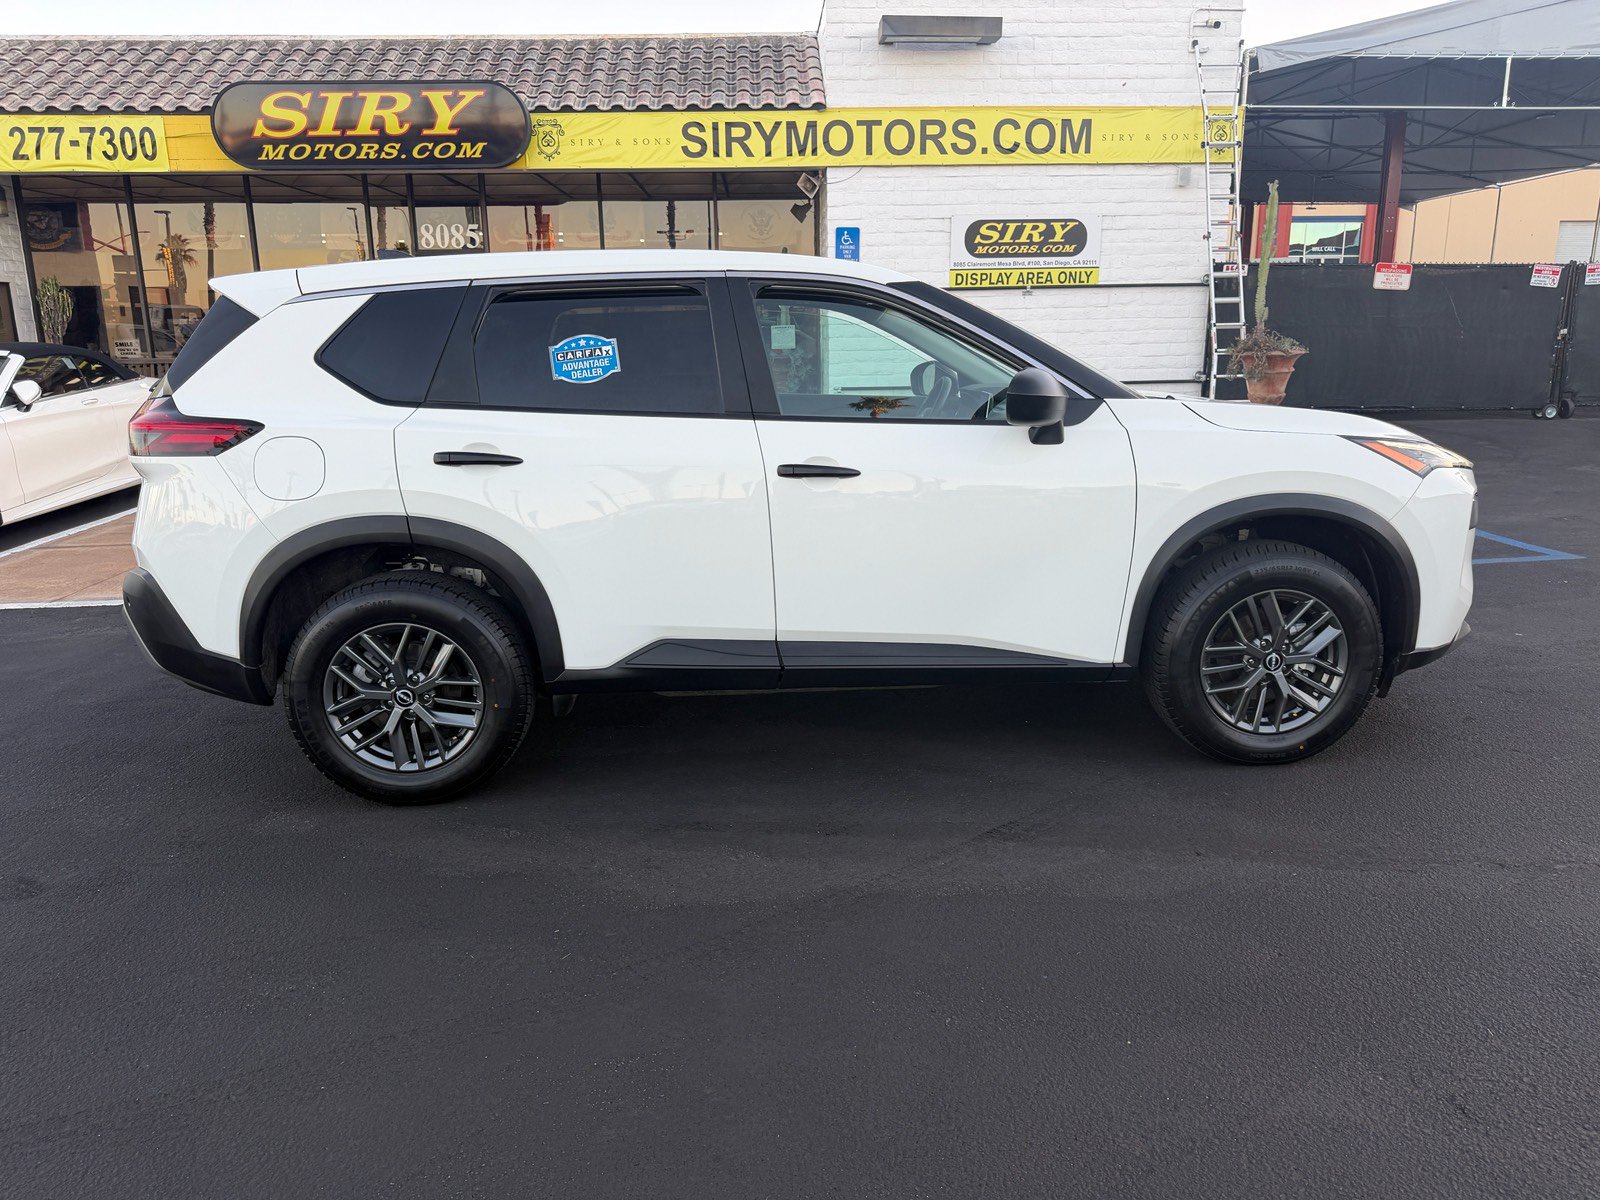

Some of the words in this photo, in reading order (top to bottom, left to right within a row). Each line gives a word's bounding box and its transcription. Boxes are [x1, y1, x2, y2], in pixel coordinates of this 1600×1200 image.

[251, 89, 487, 139] SIRY
[9, 126, 157, 161] 277-7300
[570, 138, 605, 147] SIRY
[615, 138, 622, 146] &
[632, 137, 672, 146] SONS
[680, 117, 1093, 159] SIRYMOTORS.COM
[1101, 133, 1135, 142] SIRY
[1161, 133, 1200, 141] SONS
[257, 141, 488, 161] MOTORS.COM
[419, 222, 480, 250] 8085
[974, 221, 1079, 244] SIRY
[974, 244, 1078, 254] MOTORS.COM
[955, 272, 1013, 286] DISPLAY
[1016, 271, 1054, 285] AREA
[1057, 270, 1094, 284] ONLY
[556, 345, 613, 362] CARFAX
[562, 358, 610, 371] ADVANTAGE
[571, 367, 604, 379] DEALER
